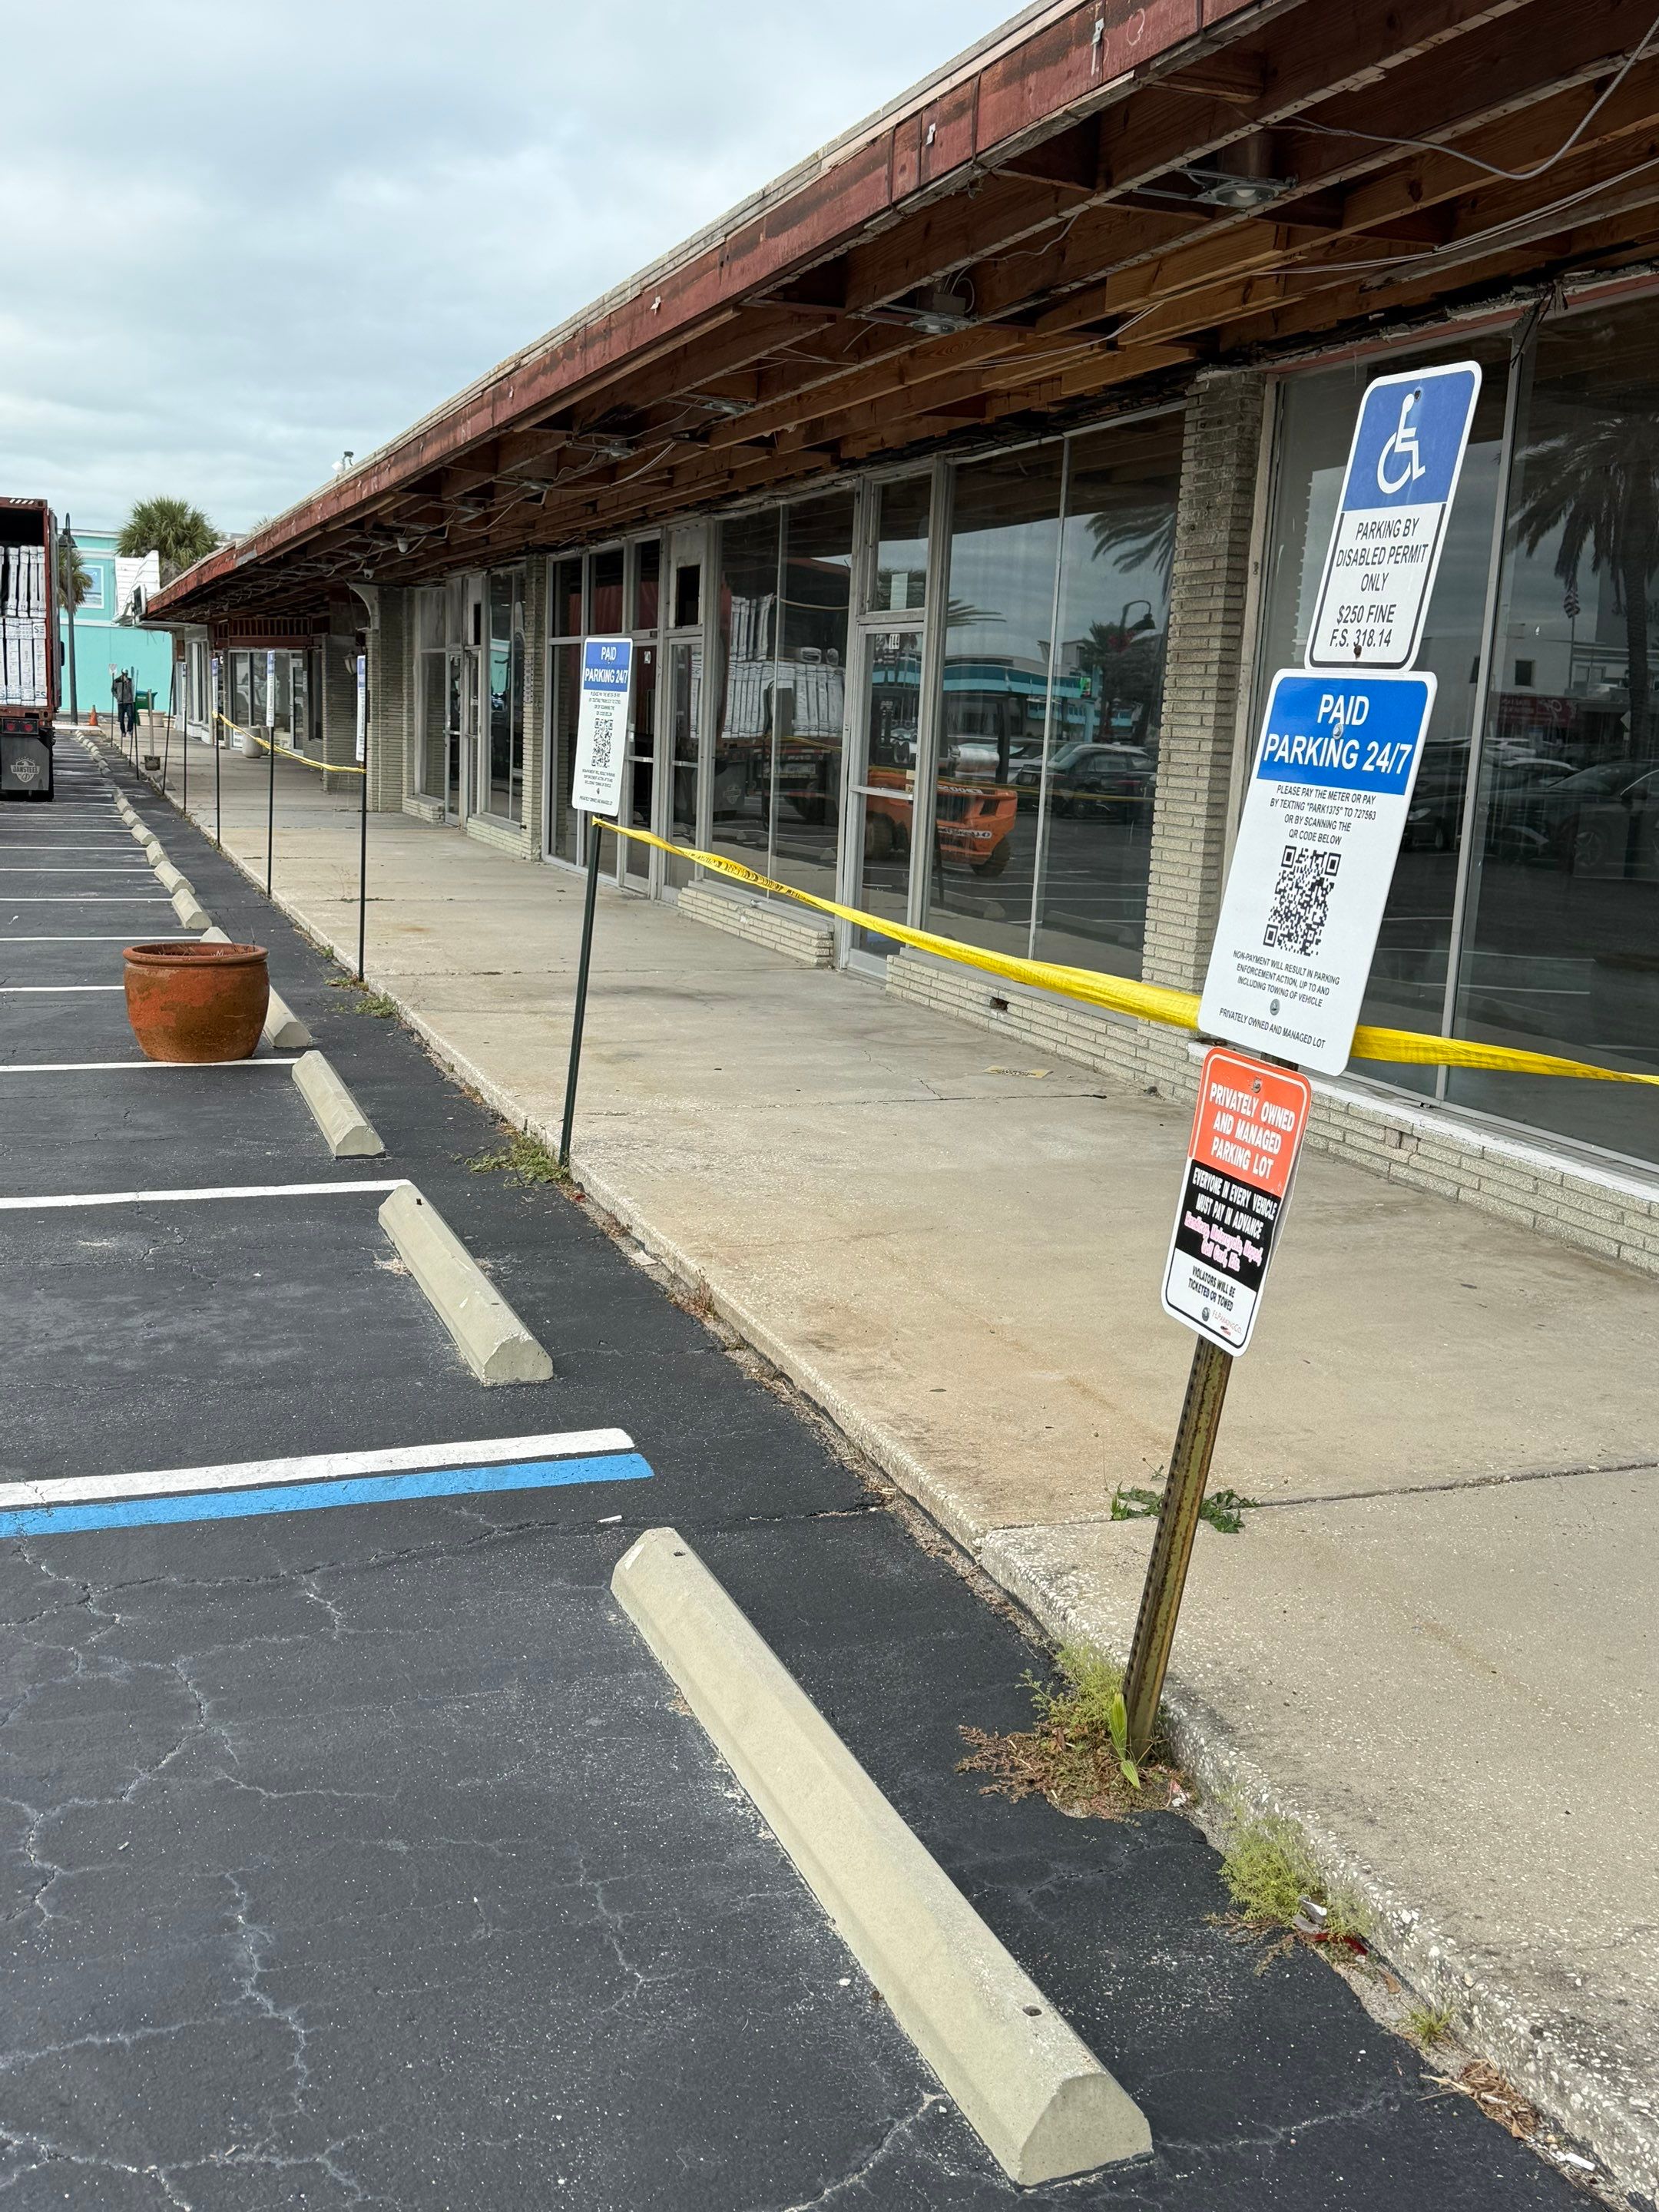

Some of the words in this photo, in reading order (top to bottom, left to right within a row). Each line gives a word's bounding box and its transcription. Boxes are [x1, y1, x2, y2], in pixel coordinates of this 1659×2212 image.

[1356, 519, 1401, 540] PARKING
[1402, 518, 1419, 537] BY
[1336, 547, 1386, 567] DISABLED
[1388, 544, 1429, 564] PERMIT
[1360, 572, 1388, 592] ONLY
[1336, 604, 1364, 624] $250
[1366, 604, 1396, 623] FINE
[1330, 630, 1349, 647] F.S.
[1353, 629, 1391, 647] 318.14
[601, 647, 616, 661] PAID
[585, 668, 614, 683] PARKING
[615, 670, 628, 684] 24/7
[1317, 694, 1369, 725] PAID
[1263, 733, 1359, 770] PARKING
[1363, 742, 1412, 774] 24/7
[1270, 798, 1279, 807] BY
[1280, 800, 1306, 810] TEXTING
[1344, 807, 1353, 816] TO
[1354, 810, 1376, 820] 727563
[1277, 785, 1300, 796] PLEASE
[1301, 788, 1314, 797] PAY
[1315, 790, 1326, 799] THE
[1327, 791, 1350, 802] METER
[1351, 793, 1361, 803] OR
[1363, 795, 1376, 805] PAY
[1284, 814, 1293, 823] OR
[1295, 816, 1303, 825] BY
[1304, 817, 1337, 830] SCANNING
[1339, 822, 1352, 832] THE
[1289, 830, 1299, 839] QR
[1299, 831, 1317, 842] CODE
[1318, 833, 1342, 845] BELOW
[1233, 950, 1270, 966] NON-PAYMENT
[1270, 959, 1283, 970] WILL
[1284, 962, 1306, 975] RESULT
[1307, 969, 1313, 977] IN
[1314, 970, 1339, 985] PARKING
[1237, 964, 1276, 982] ENFORCEMENT
[1300, 980, 1307, 988] UP
[1309, 982, 1316, 992] TO
[1316, 985, 1330, 995] AND
[1237, 976, 1266, 990] INCLUDING
[1267, 985, 1289, 998] TOWING
[1298, 993, 1323, 1007] VEHICLE
[1220, 1008, 1247, 1025] PRIVATELY
[1248, 1017, 1269, 1031] OWNED
[1270, 1023, 1282, 1035] AND
[1283, 1028, 1313, 1044] MANAGED
[1313, 1038, 1326, 1048] LOT
[1209, 1082, 1260, 1118] PRIVATELY
[1261, 1101, 1296, 1132] OWNED
[1213, 1111, 1234, 1135] AND
[1235, 1118, 1282, 1154] MANAGED
[1211, 1136, 1251, 1171] PARKING
[1253, 1154, 1274, 1179] LOT
[1193, 1168, 1223, 1194] EVERYONE
[1224, 1181, 1229, 1199] IN
[1230, 1184, 1251, 1208] EVERY
[1252, 1191, 1277, 1220] VEHICLE
[1196, 1194, 1212, 1215] MUST
[1213, 1202, 1224, 1221] PAY
[1224, 1207, 1233, 1225] IN
[1233, 1211, 1263, 1239] ADVANCE
[1189, 1278, 1210, 1299] TICKETED
[1210, 1290, 1217, 1303] OR
[1217, 1293, 1233, 1312] TOWED
[1192, 1266, 1217, 1287] VIOLATORS
[1217, 1277, 1228, 1293] WILL
[1229, 1287, 1236, 1298] BE
